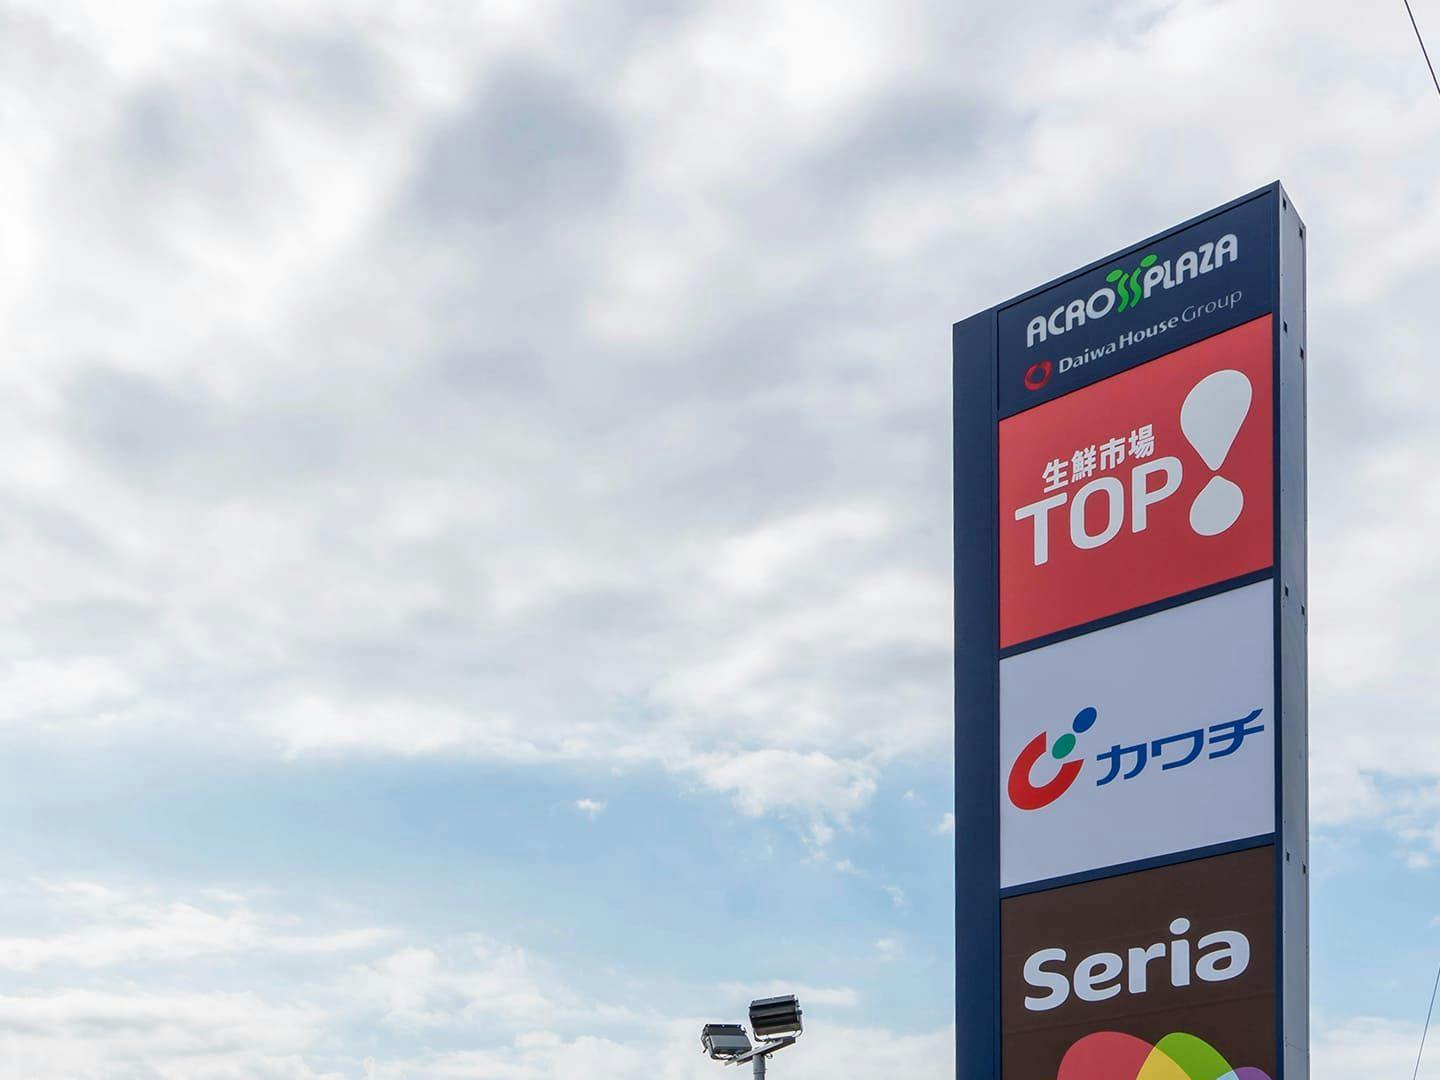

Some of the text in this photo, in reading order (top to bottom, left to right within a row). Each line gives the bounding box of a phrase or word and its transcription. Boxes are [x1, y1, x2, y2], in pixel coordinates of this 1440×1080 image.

[1059, 289, 1243, 374] Daiwa House Group
[1042, 423, 1155, 493] 生鮮市場
[1096, 707, 1265, 787] カワチ
[1023, 917, 1251, 1012] Seria
